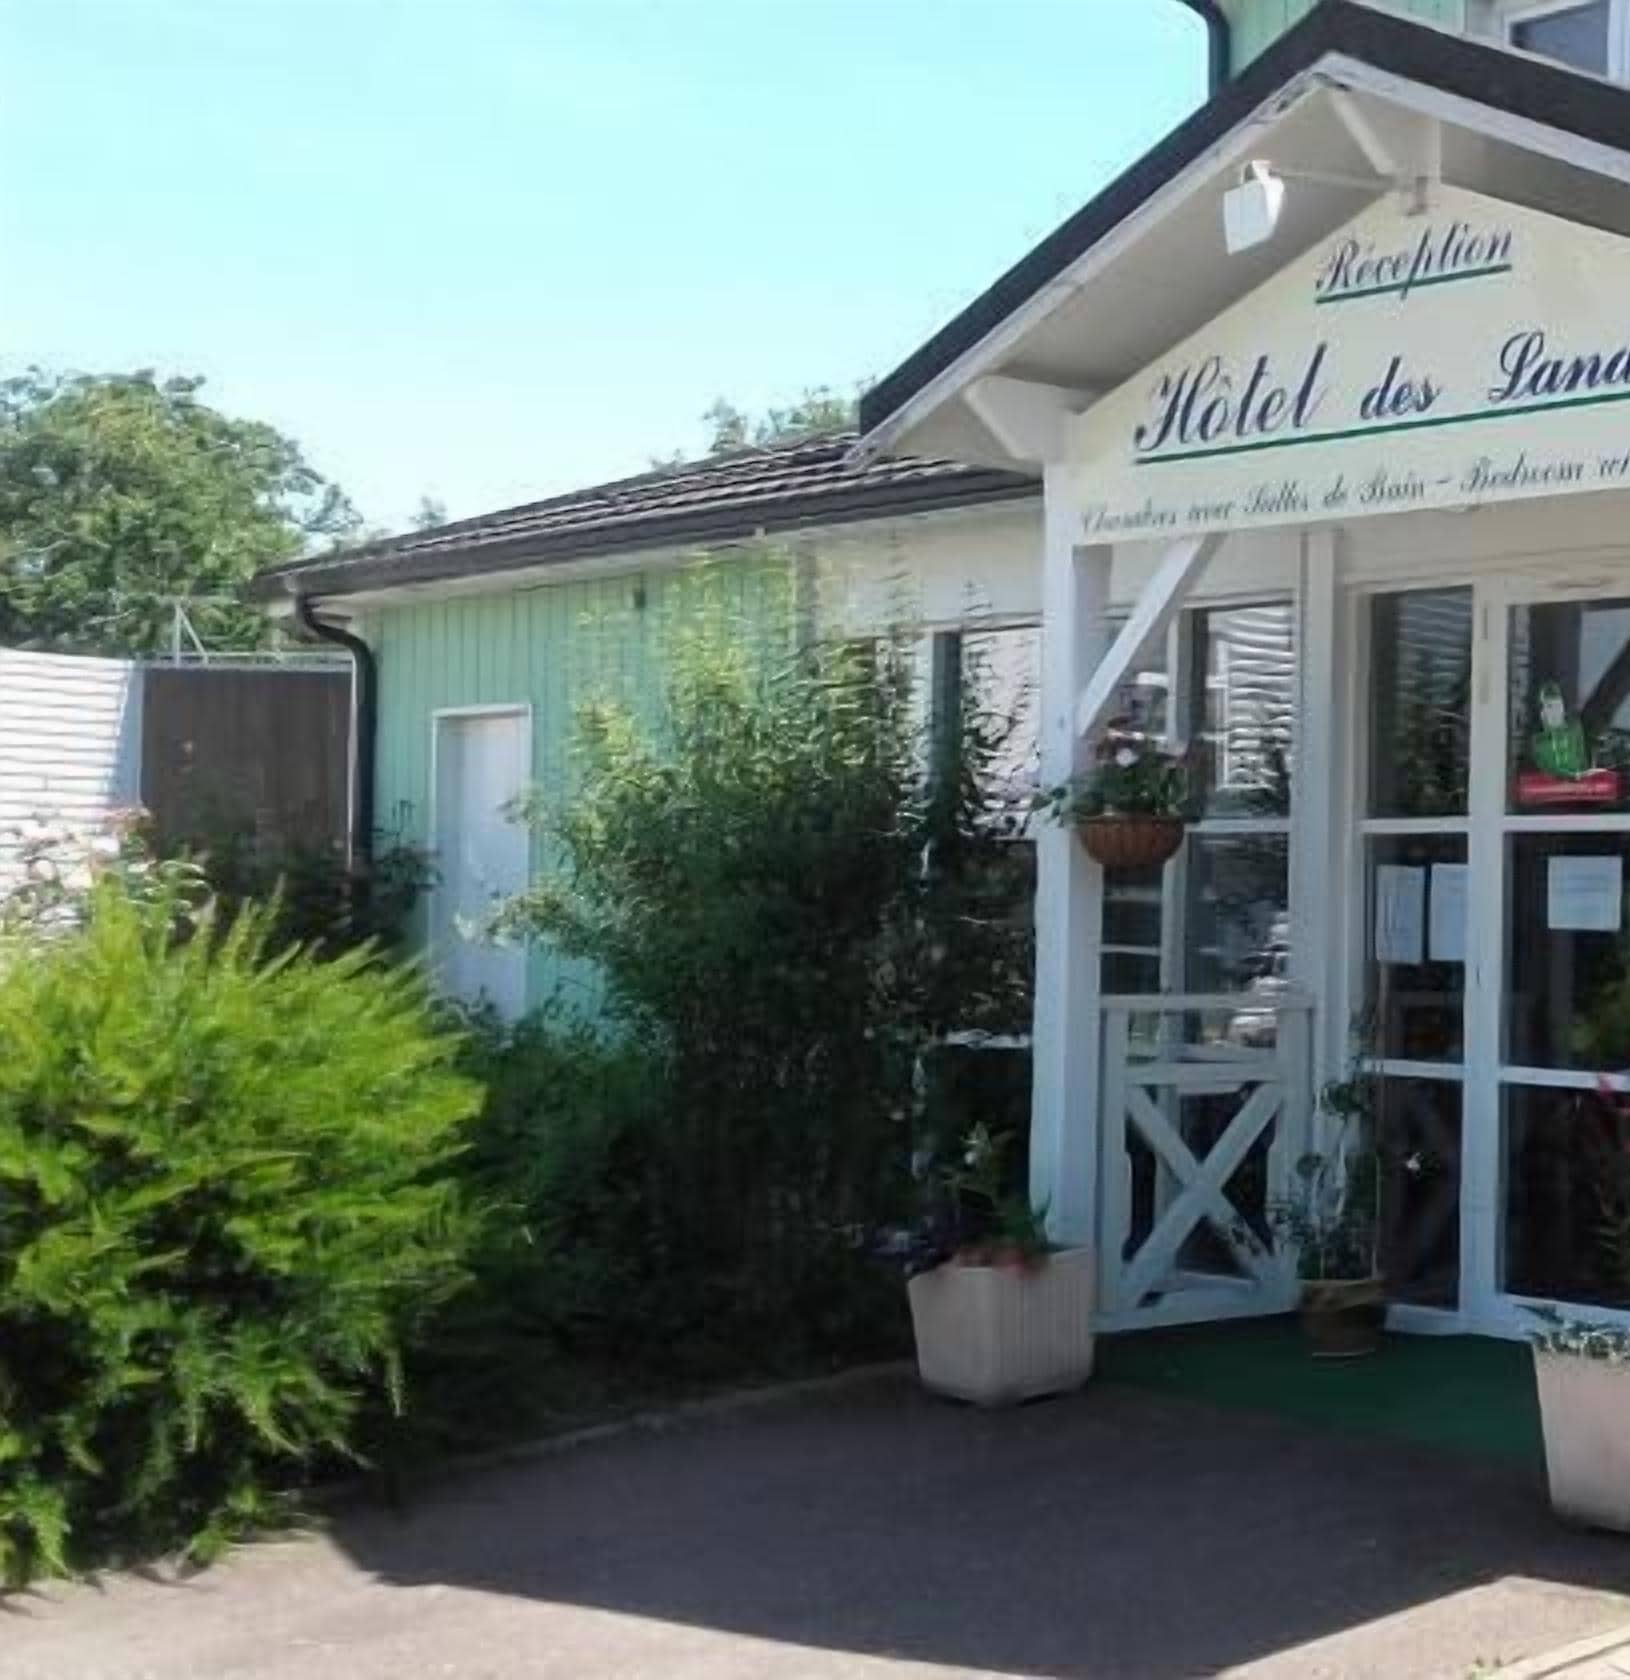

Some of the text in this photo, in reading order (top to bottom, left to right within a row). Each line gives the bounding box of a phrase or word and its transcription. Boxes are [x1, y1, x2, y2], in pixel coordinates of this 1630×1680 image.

[1316, 223, 1513, 299] Réception
[1134, 342, 1328, 452] Hôtel
[1360, 356, 1441, 420] des
[1321, 471, 1349, 508] de
[1359, 466, 1425, 505] Bain
[1459, 451, 1586, 493] Bedroom
